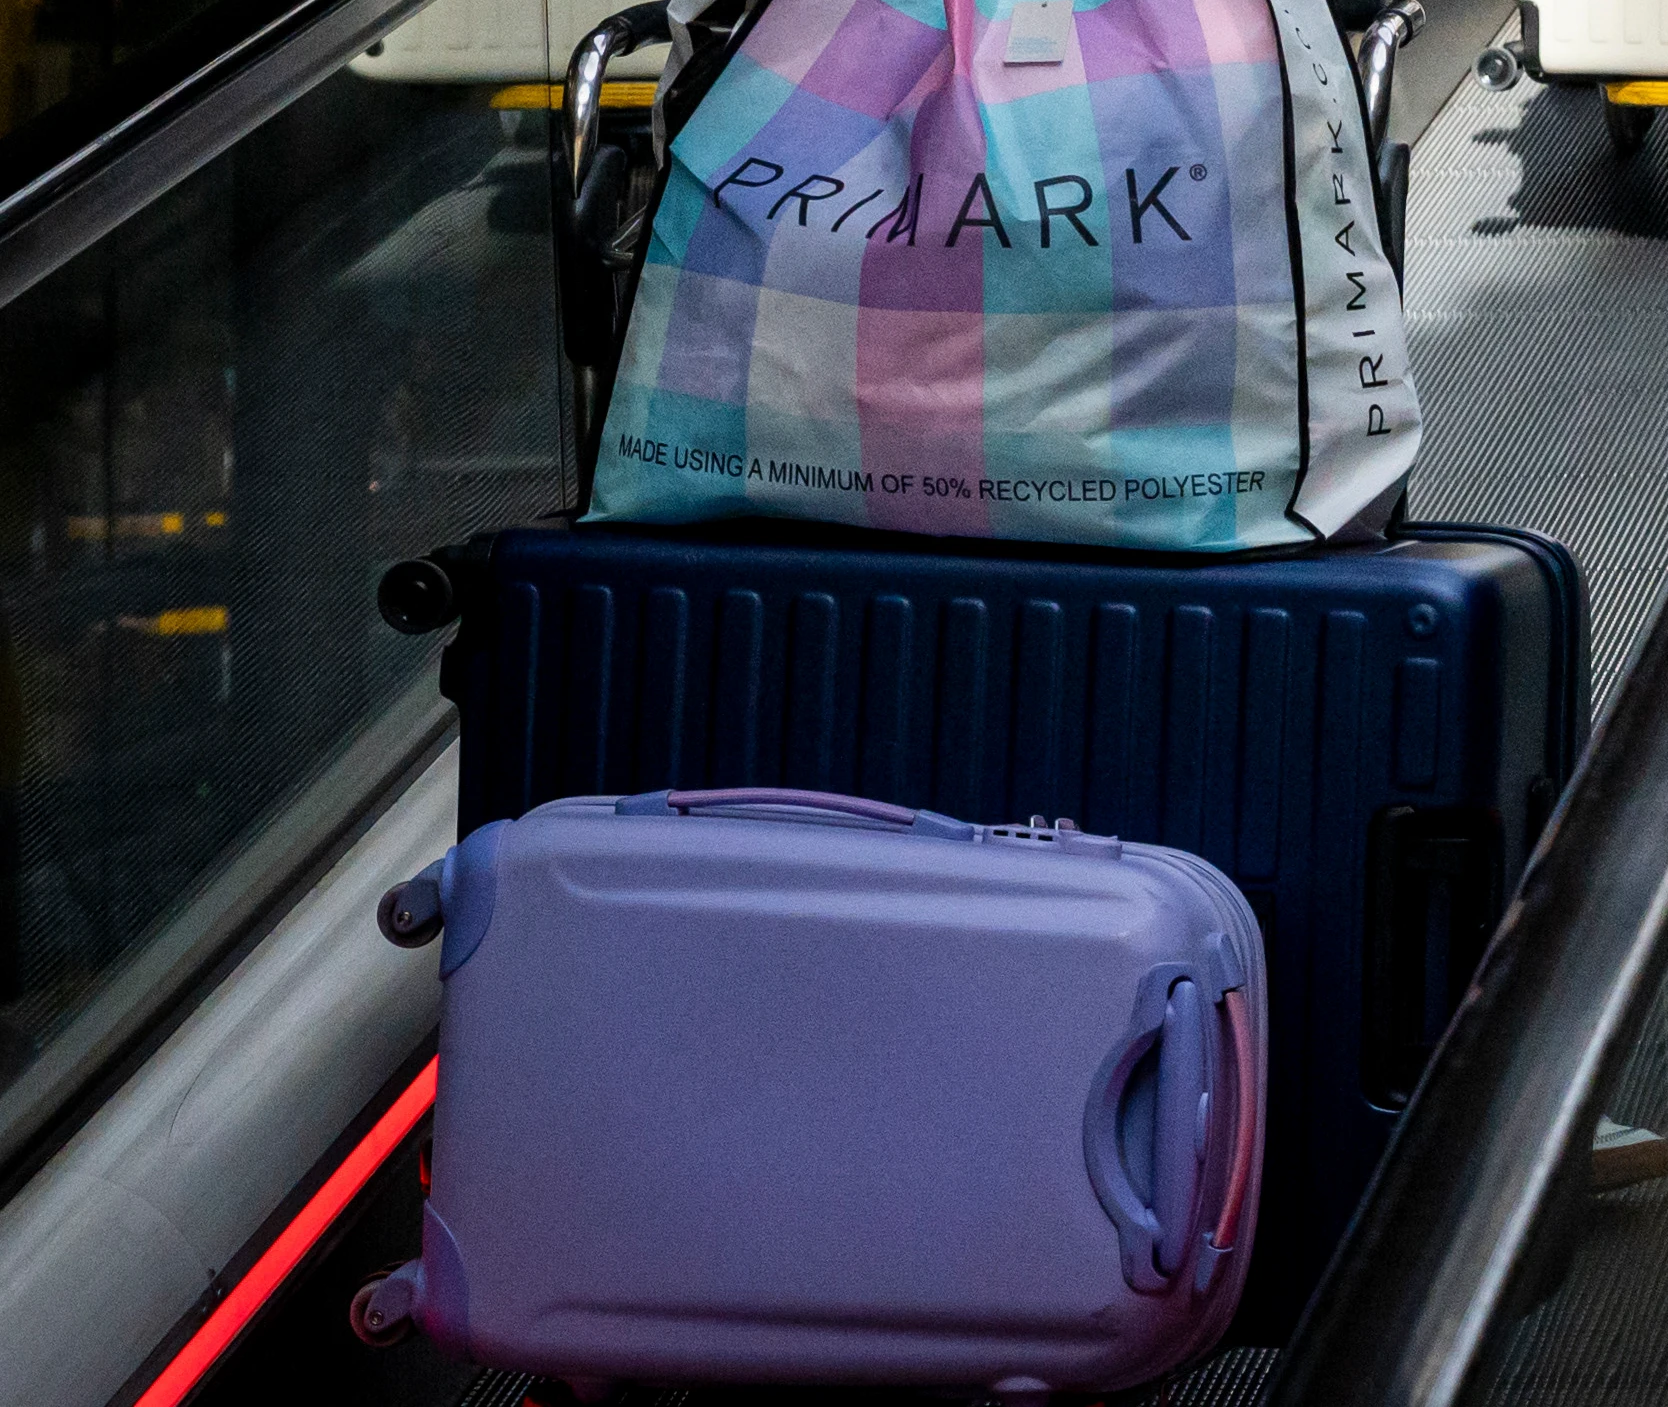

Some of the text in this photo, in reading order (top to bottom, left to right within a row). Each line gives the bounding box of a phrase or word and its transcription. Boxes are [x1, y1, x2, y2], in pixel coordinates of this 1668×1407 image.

[618, 433, 1266, 502] MADE USING A MINIMUM OF 50% RECYCLED POLYESTER
